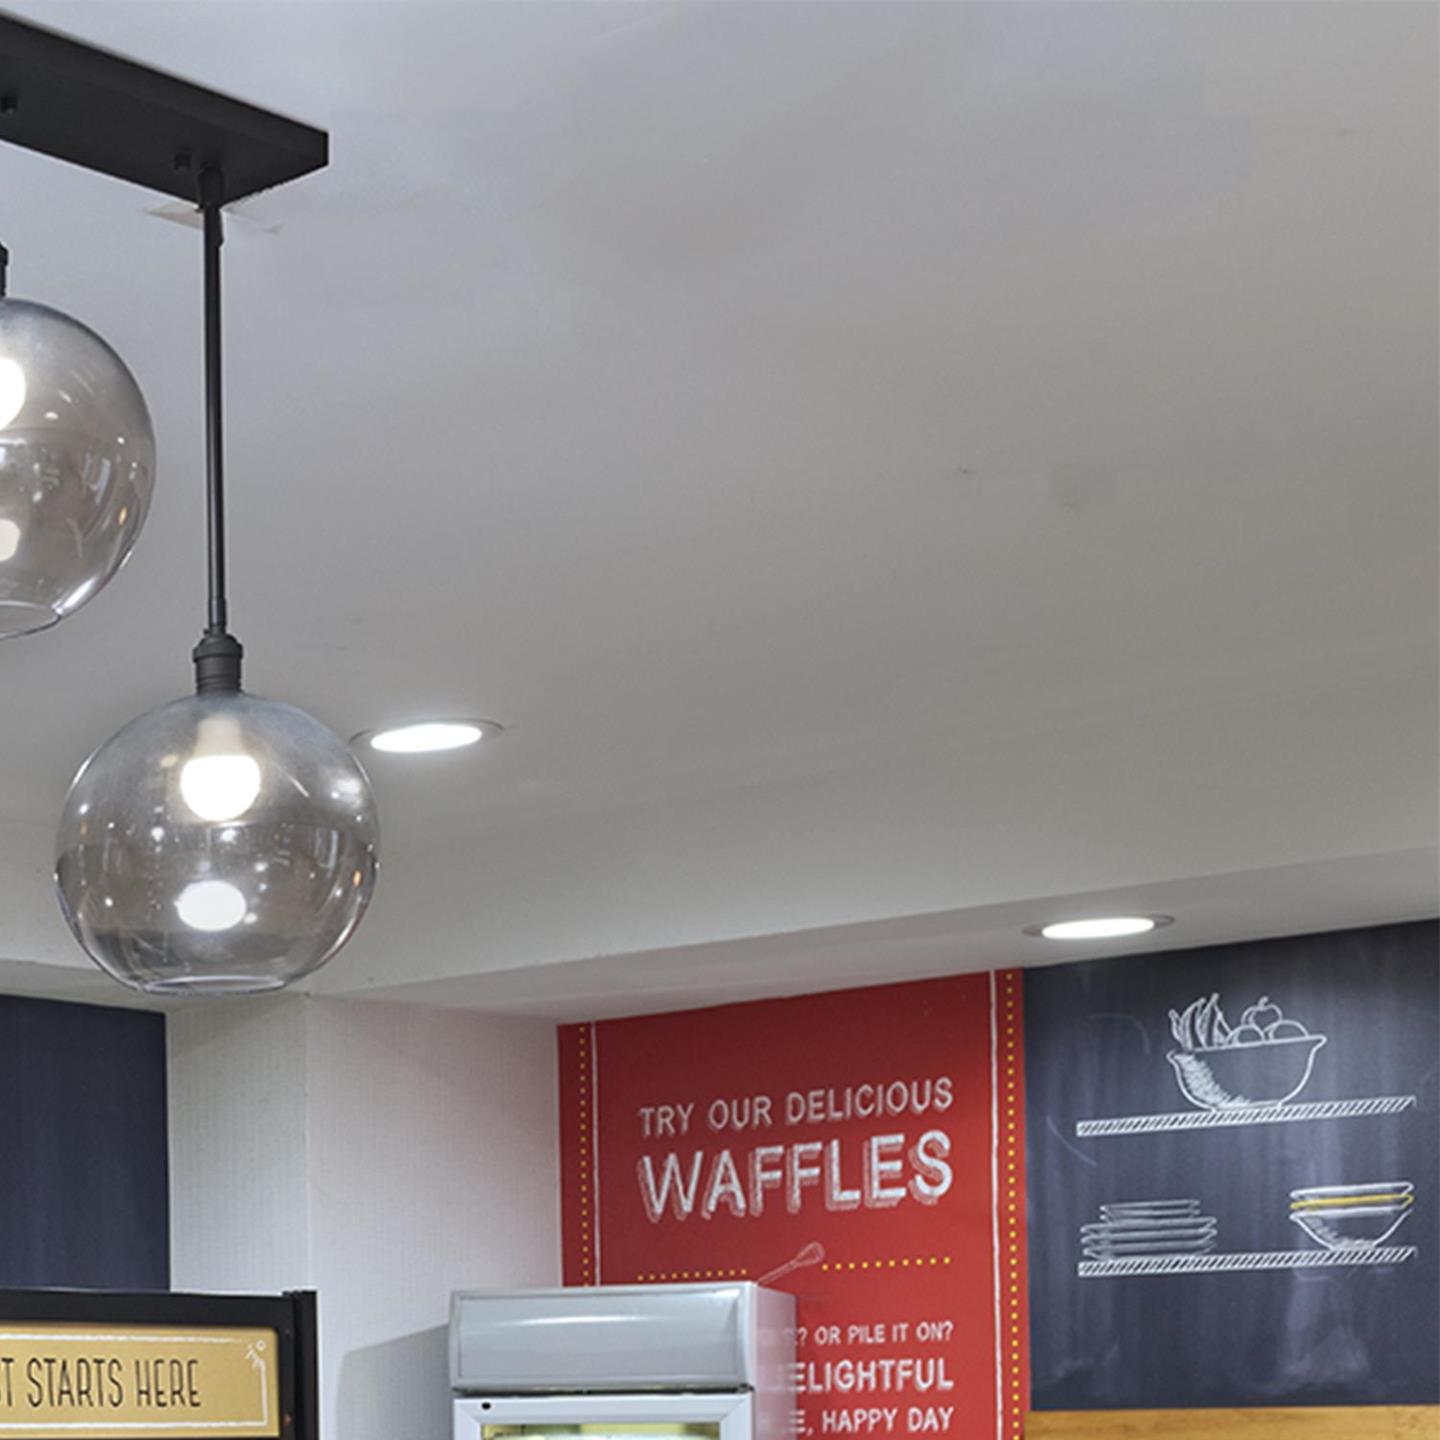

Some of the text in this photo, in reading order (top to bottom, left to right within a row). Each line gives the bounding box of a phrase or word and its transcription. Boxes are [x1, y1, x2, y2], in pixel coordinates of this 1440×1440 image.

[638, 1076, 954, 1138] TRY OUR DELICIOUS
[638, 1129, 953, 1223] WAFFLES
[814, 1325, 841, 1345] OR
[847, 1323, 886, 1345] PILE
[892, 1322, 909, 1343] IT
[916, 1320, 954, 1342] ON?
[27, 1357, 123, 1408] STARTS
[134, 1358, 202, 1408] HERE
[822, 1408, 897, 1433] HAPPY
[907, 1406, 954, 1432] DAY
